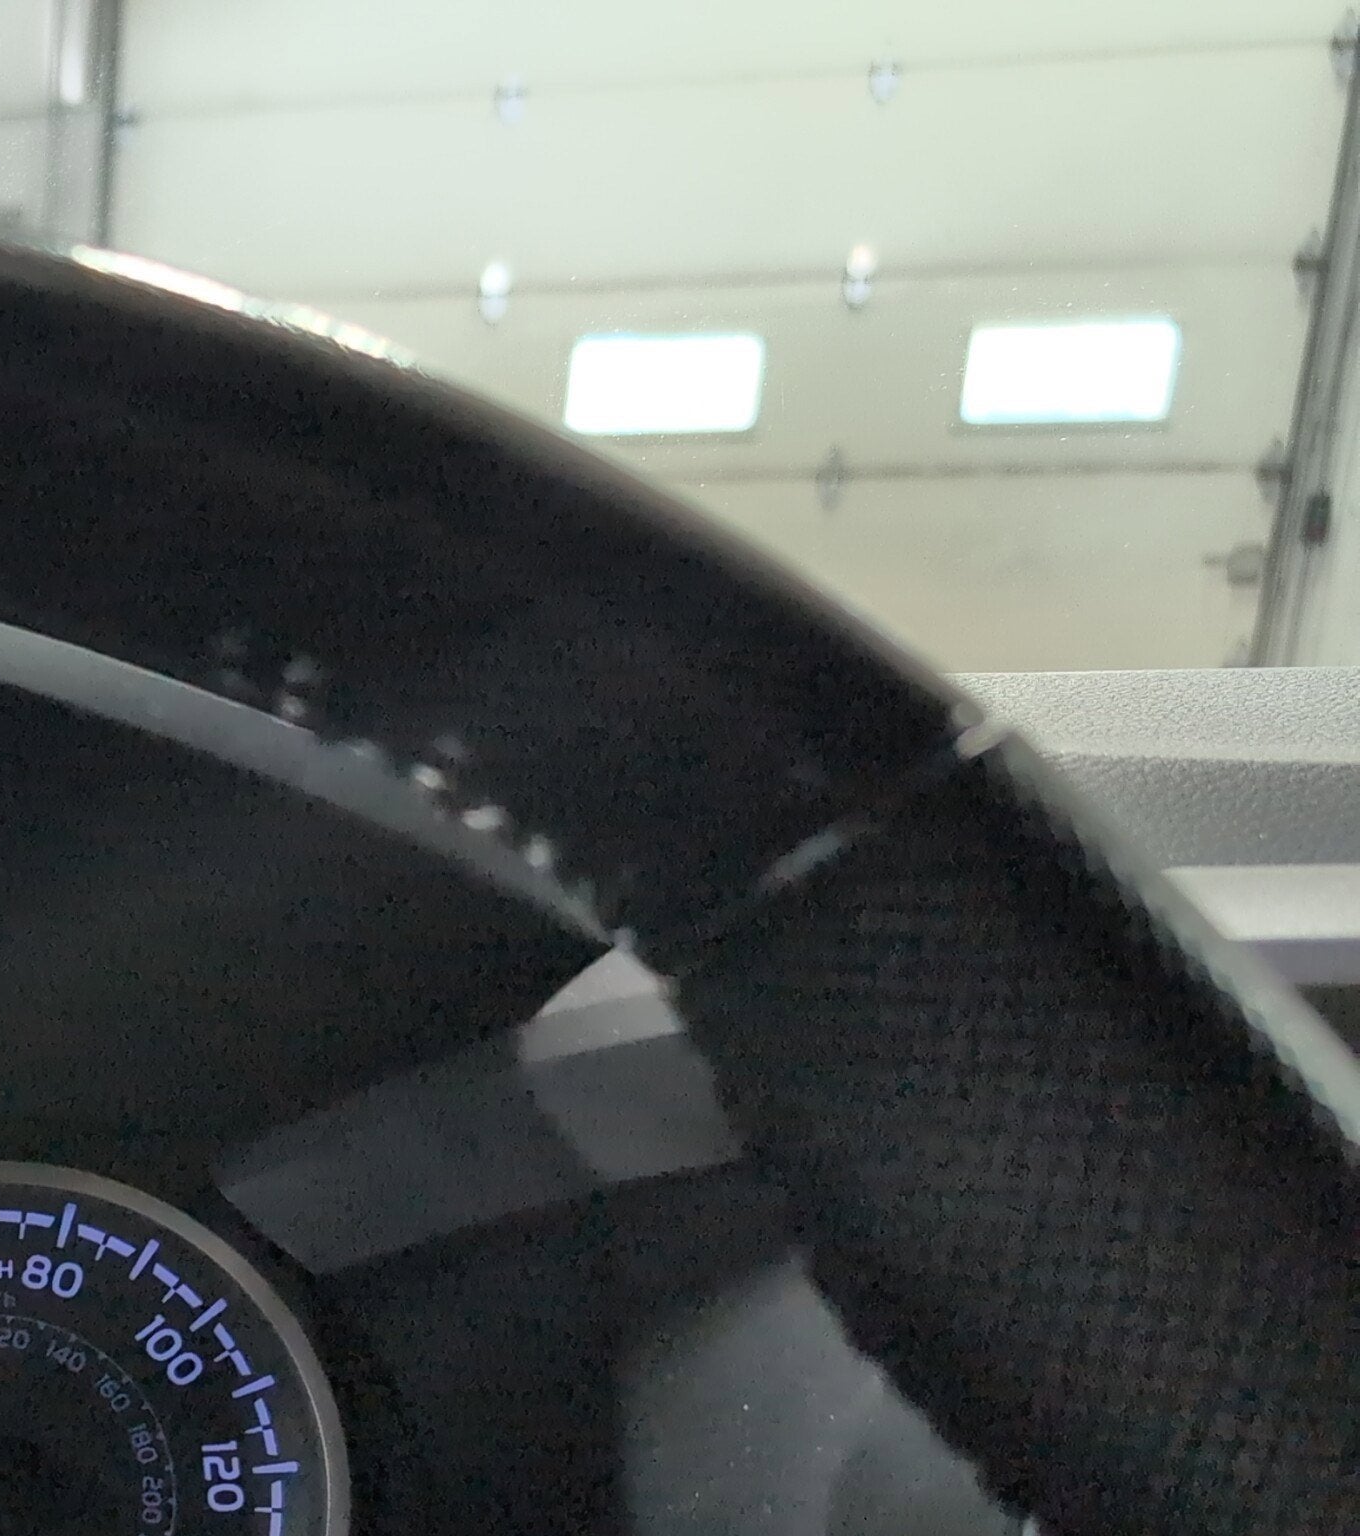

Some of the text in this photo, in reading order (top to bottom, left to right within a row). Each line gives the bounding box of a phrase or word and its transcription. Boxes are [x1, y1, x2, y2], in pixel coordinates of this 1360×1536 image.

[21, 1253, 84, 1299] 80
[45, 1338, 87, 1374] 140
[135, 1314, 203, 1386] 100
[94, 1373, 132, 1413] 160
[128, 1422, 159, 1466] 180
[201, 1438, 245, 1513] 120
[141, 1476, 164, 1525] 200
